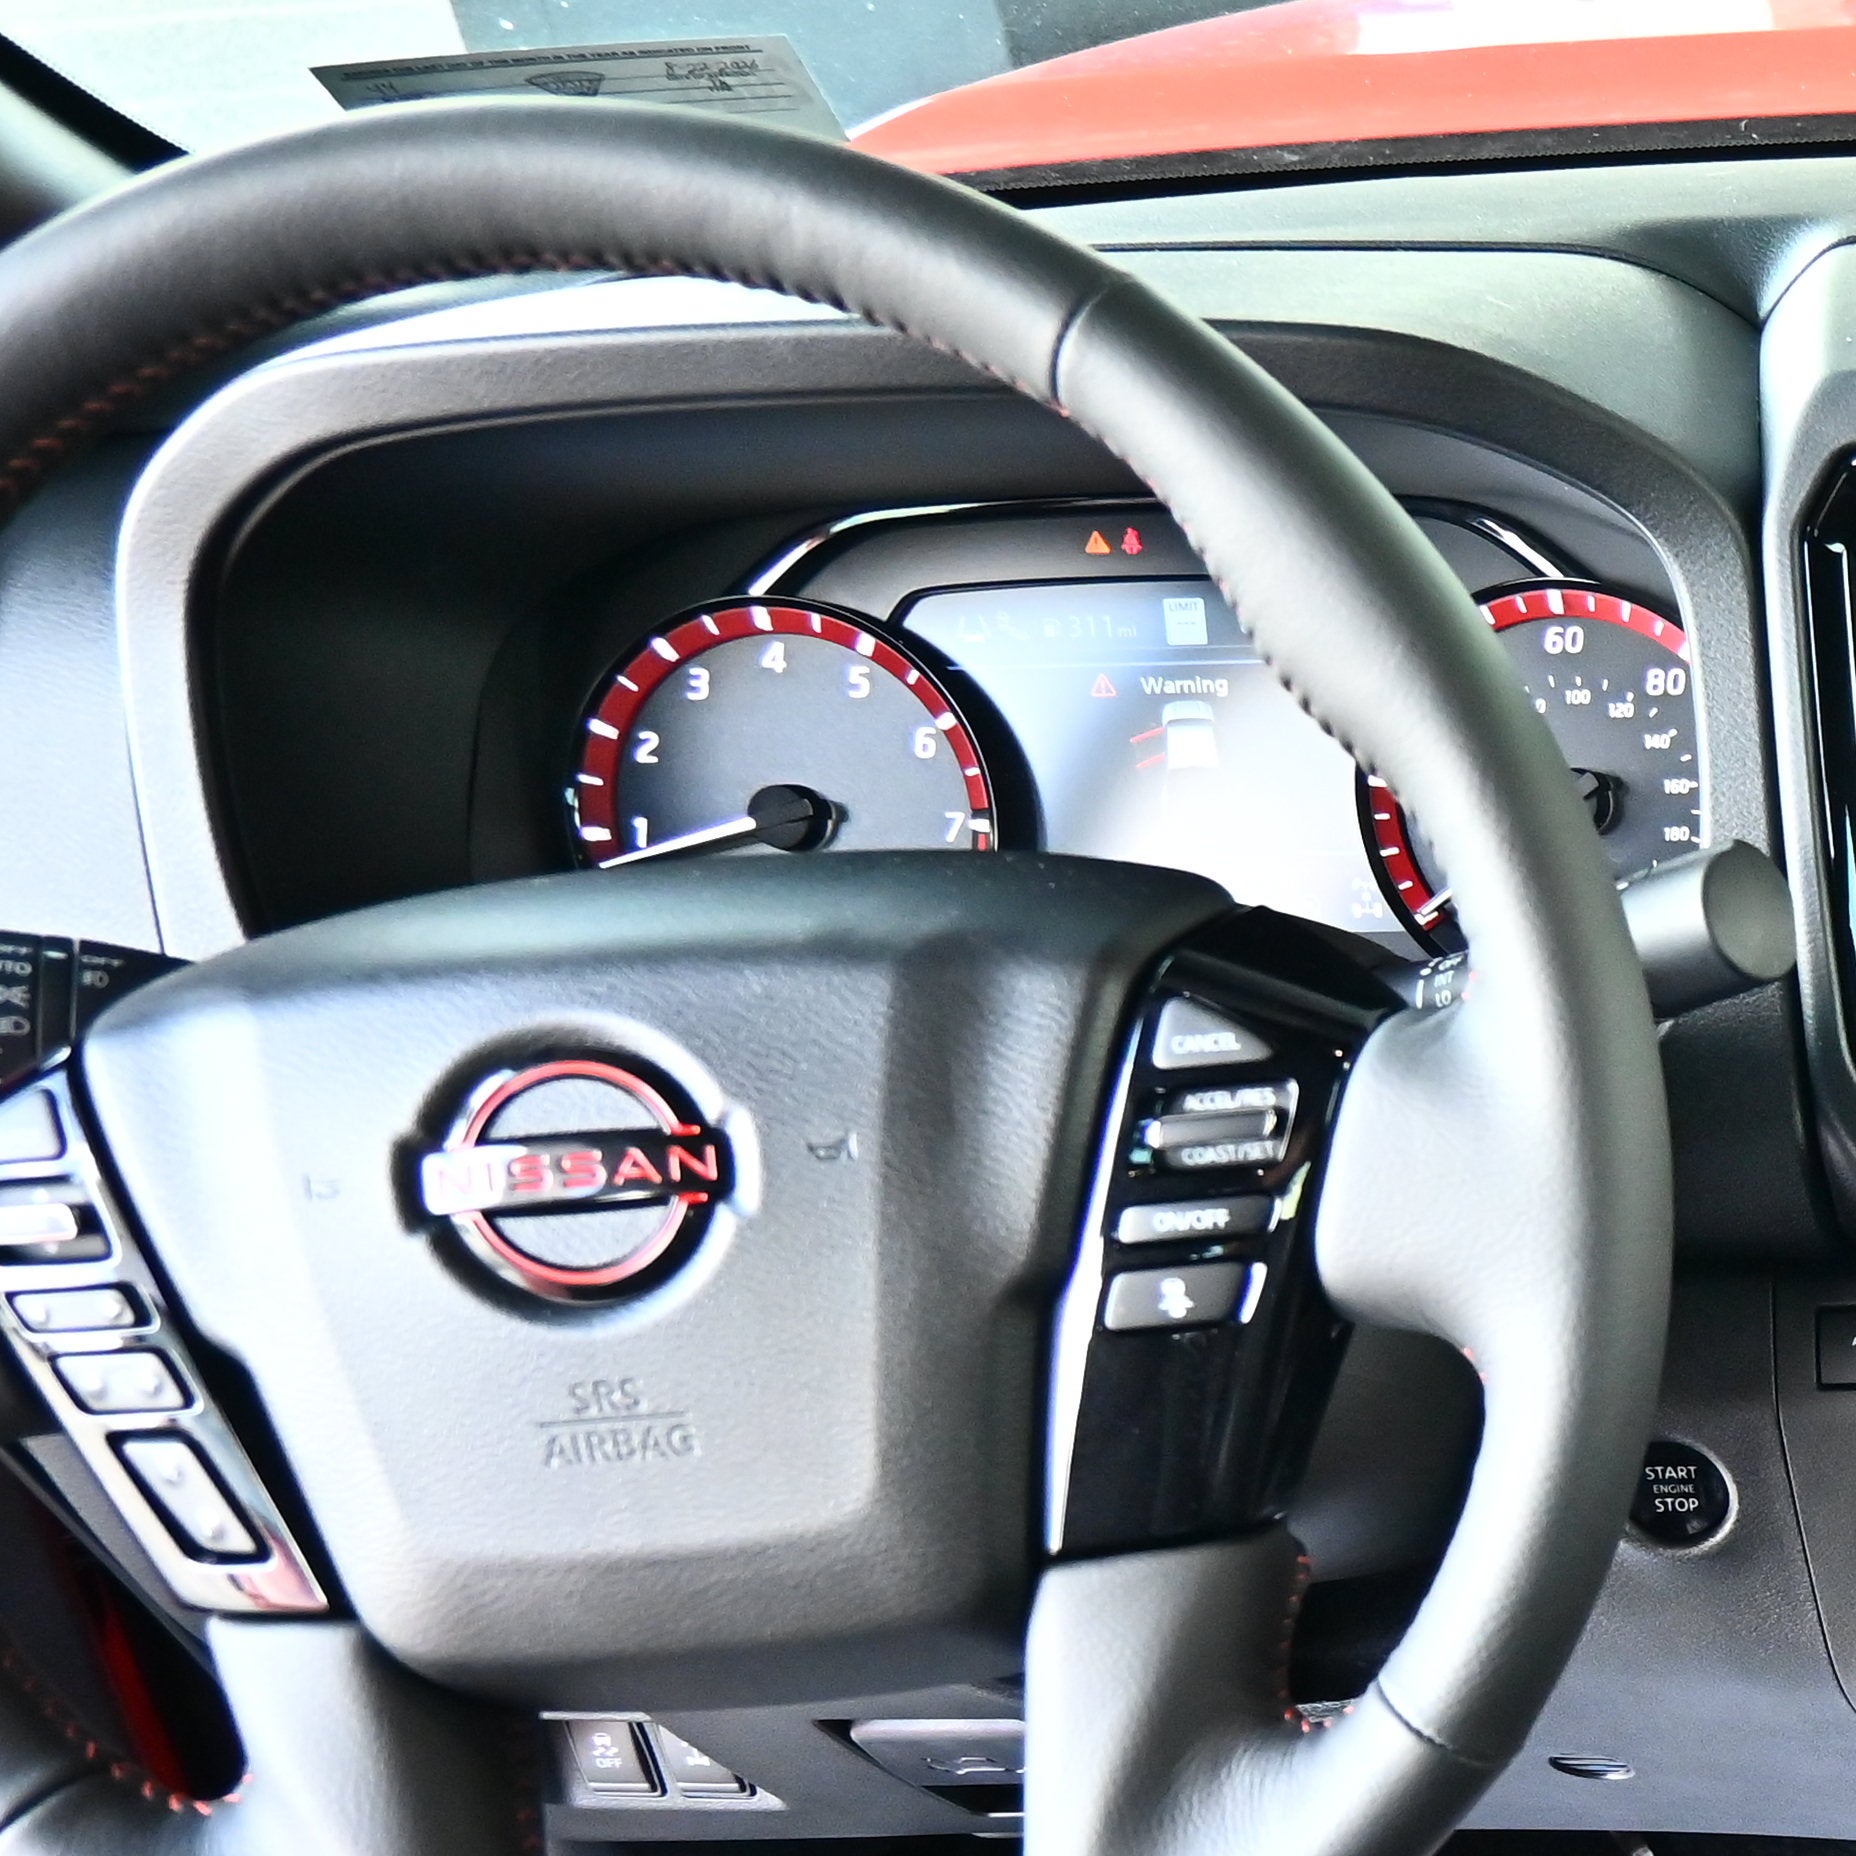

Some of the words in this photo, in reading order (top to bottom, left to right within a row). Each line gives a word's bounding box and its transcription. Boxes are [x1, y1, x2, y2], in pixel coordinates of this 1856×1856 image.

[1544, 626, 1584, 654] 60
[760, 641, 787, 672] 4
[686, 669, 711, 700] 3
[847, 668, 872, 699] 5
[1141, 675, 1229, 697] Warning
[1645, 668, 1687, 696] 80
[635, 732, 661, 764] 2
[913, 727, 938, 760] 6
[944, 811, 966, 842] 7
[1170, 1031, 1241, 1054] CANCEL
[1181, 1141, 1279, 1165] COAST/SET
[436, 1144, 718, 1197] NISSAN
[1152, 1207, 1230, 1231] ON/OFF
[566, 1376, 644, 1416] SRS
[543, 1423, 697, 1468] AIRBAG
[1645, 1466, 1697, 1480] START
[1653, 1484, 1695, 1493] ENGINE
[1654, 1498, 1699, 1512] STOP
